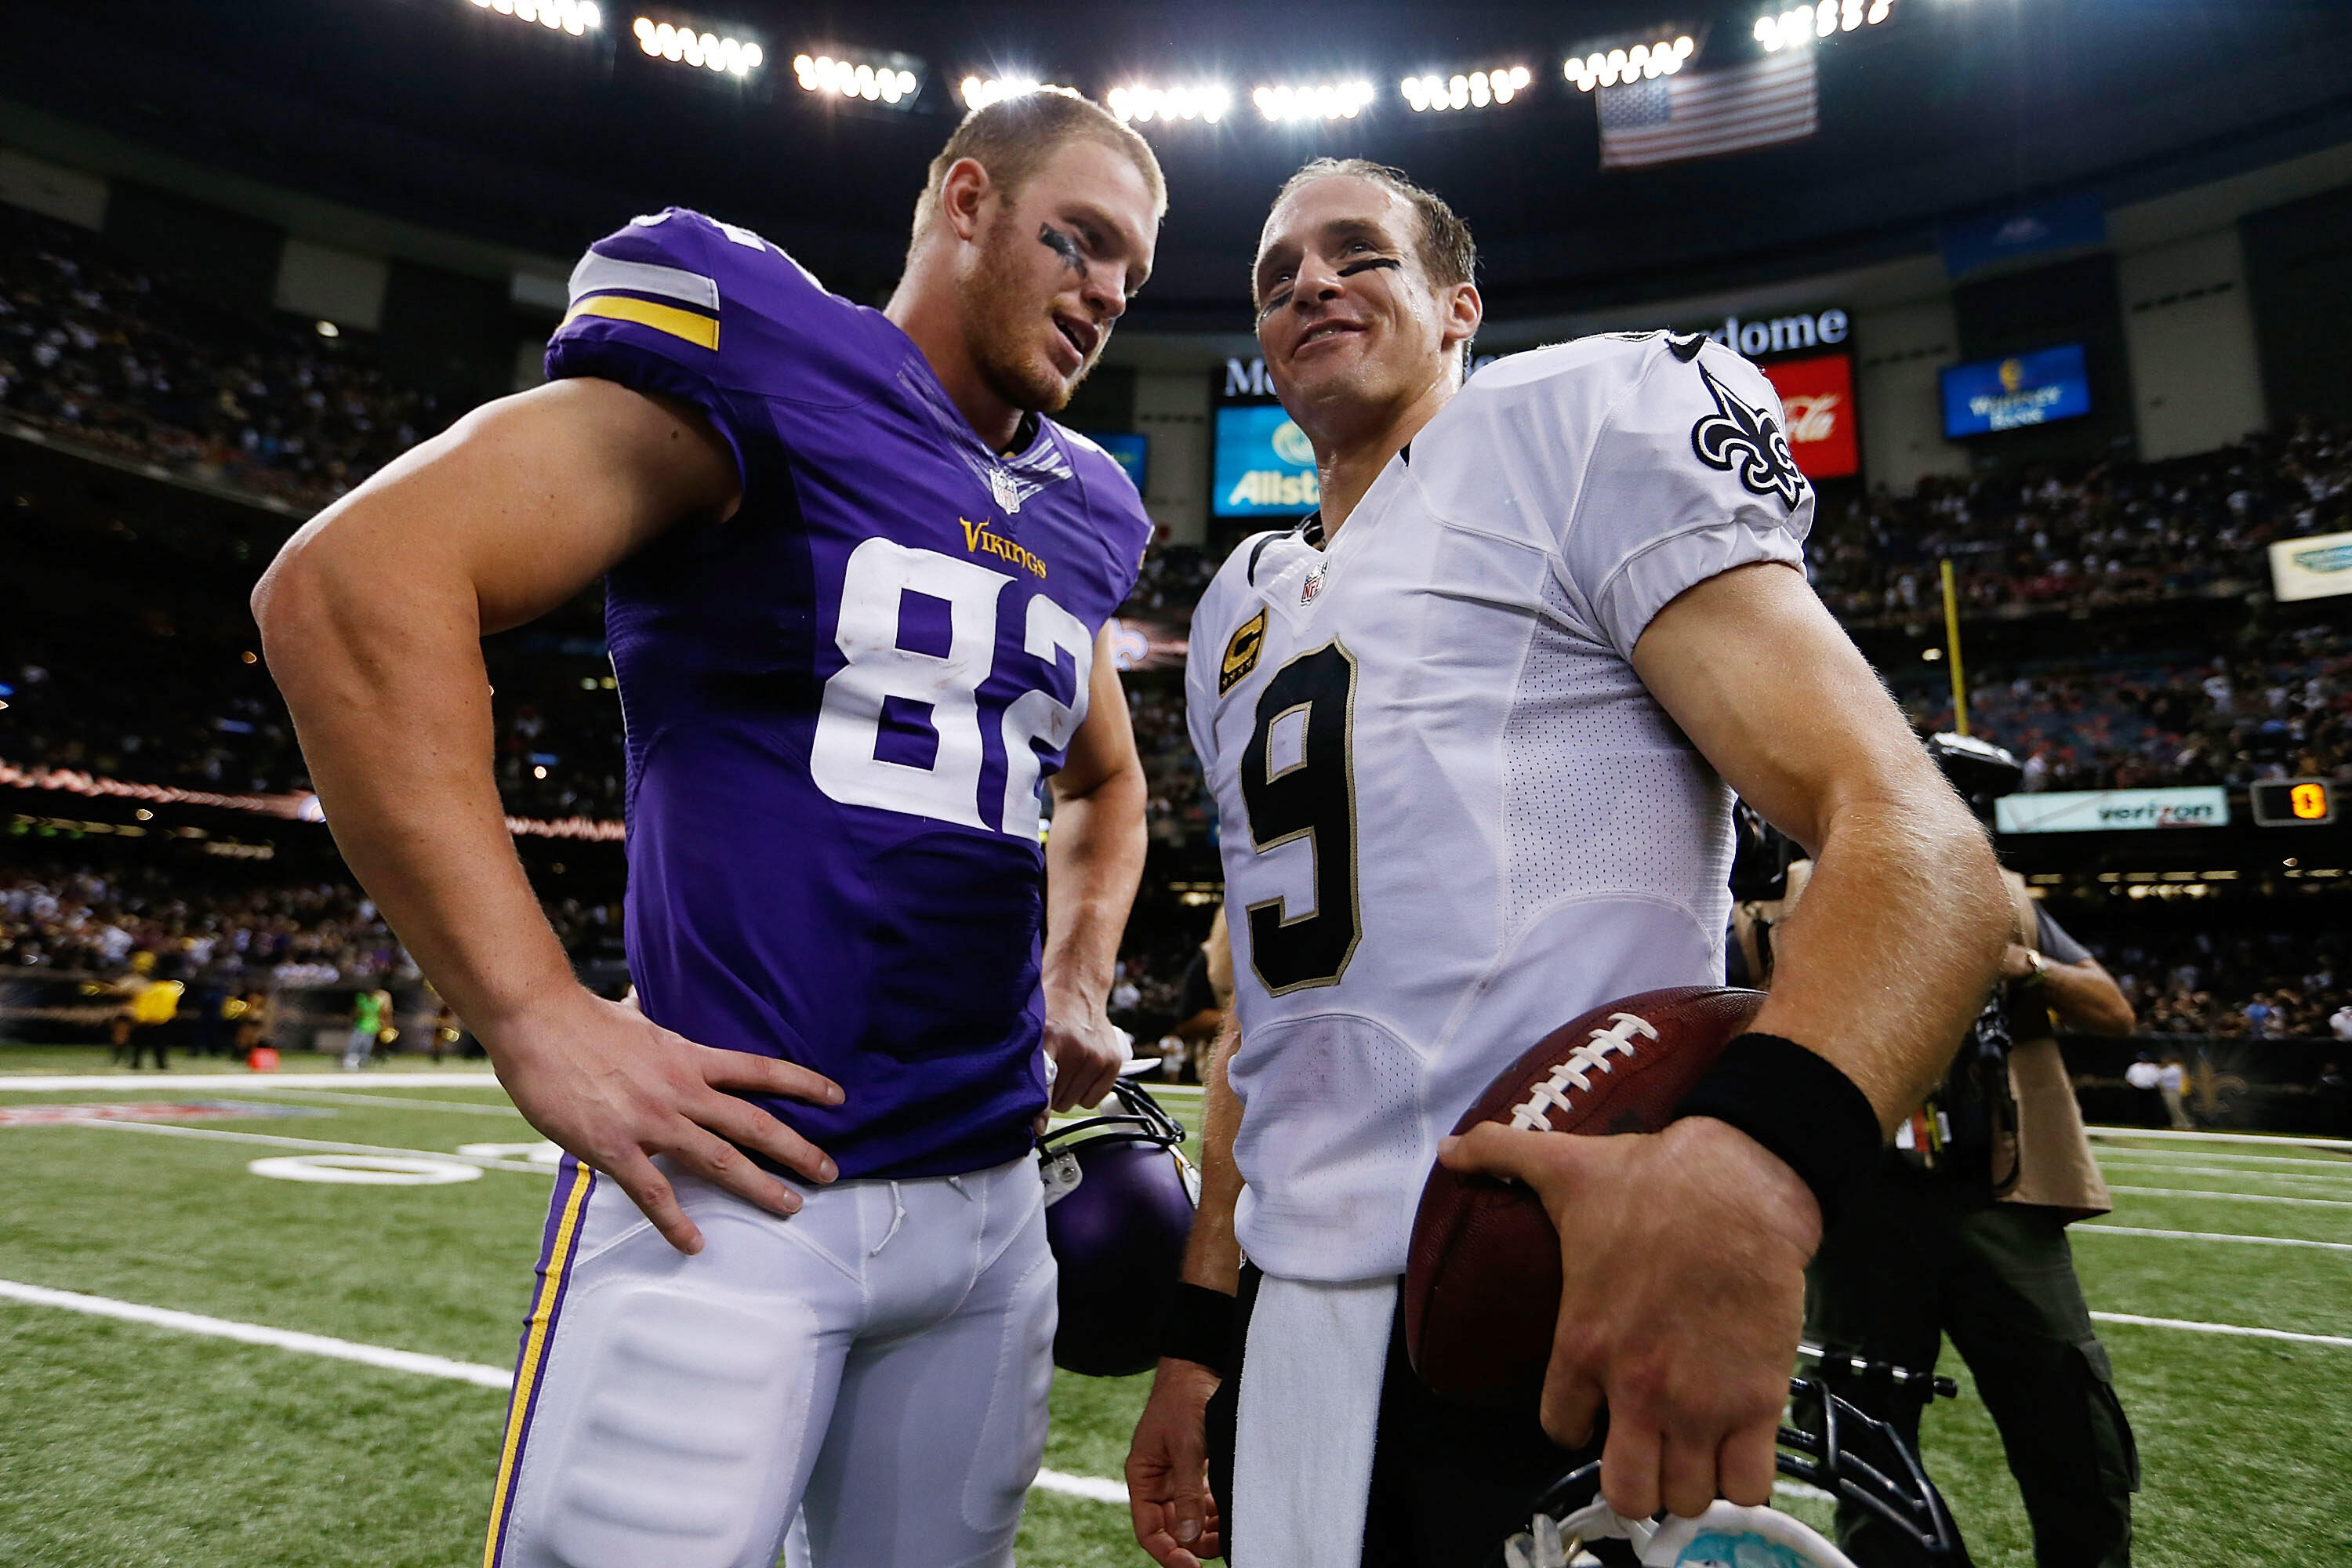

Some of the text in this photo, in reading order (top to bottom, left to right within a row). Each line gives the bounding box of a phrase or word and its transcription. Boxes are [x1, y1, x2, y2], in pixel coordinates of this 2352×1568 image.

[1706, 309, 1849, 355] dome
[1229, 470, 1319, 506] Allst
[1302, 578, 1322, 600] NFL
[1223, 615, 1263, 673] C
[810, 537, 1094, 849] 82
[1239, 634, 1363, 998] 9
[2098, 801, 2213, 826] verizon
